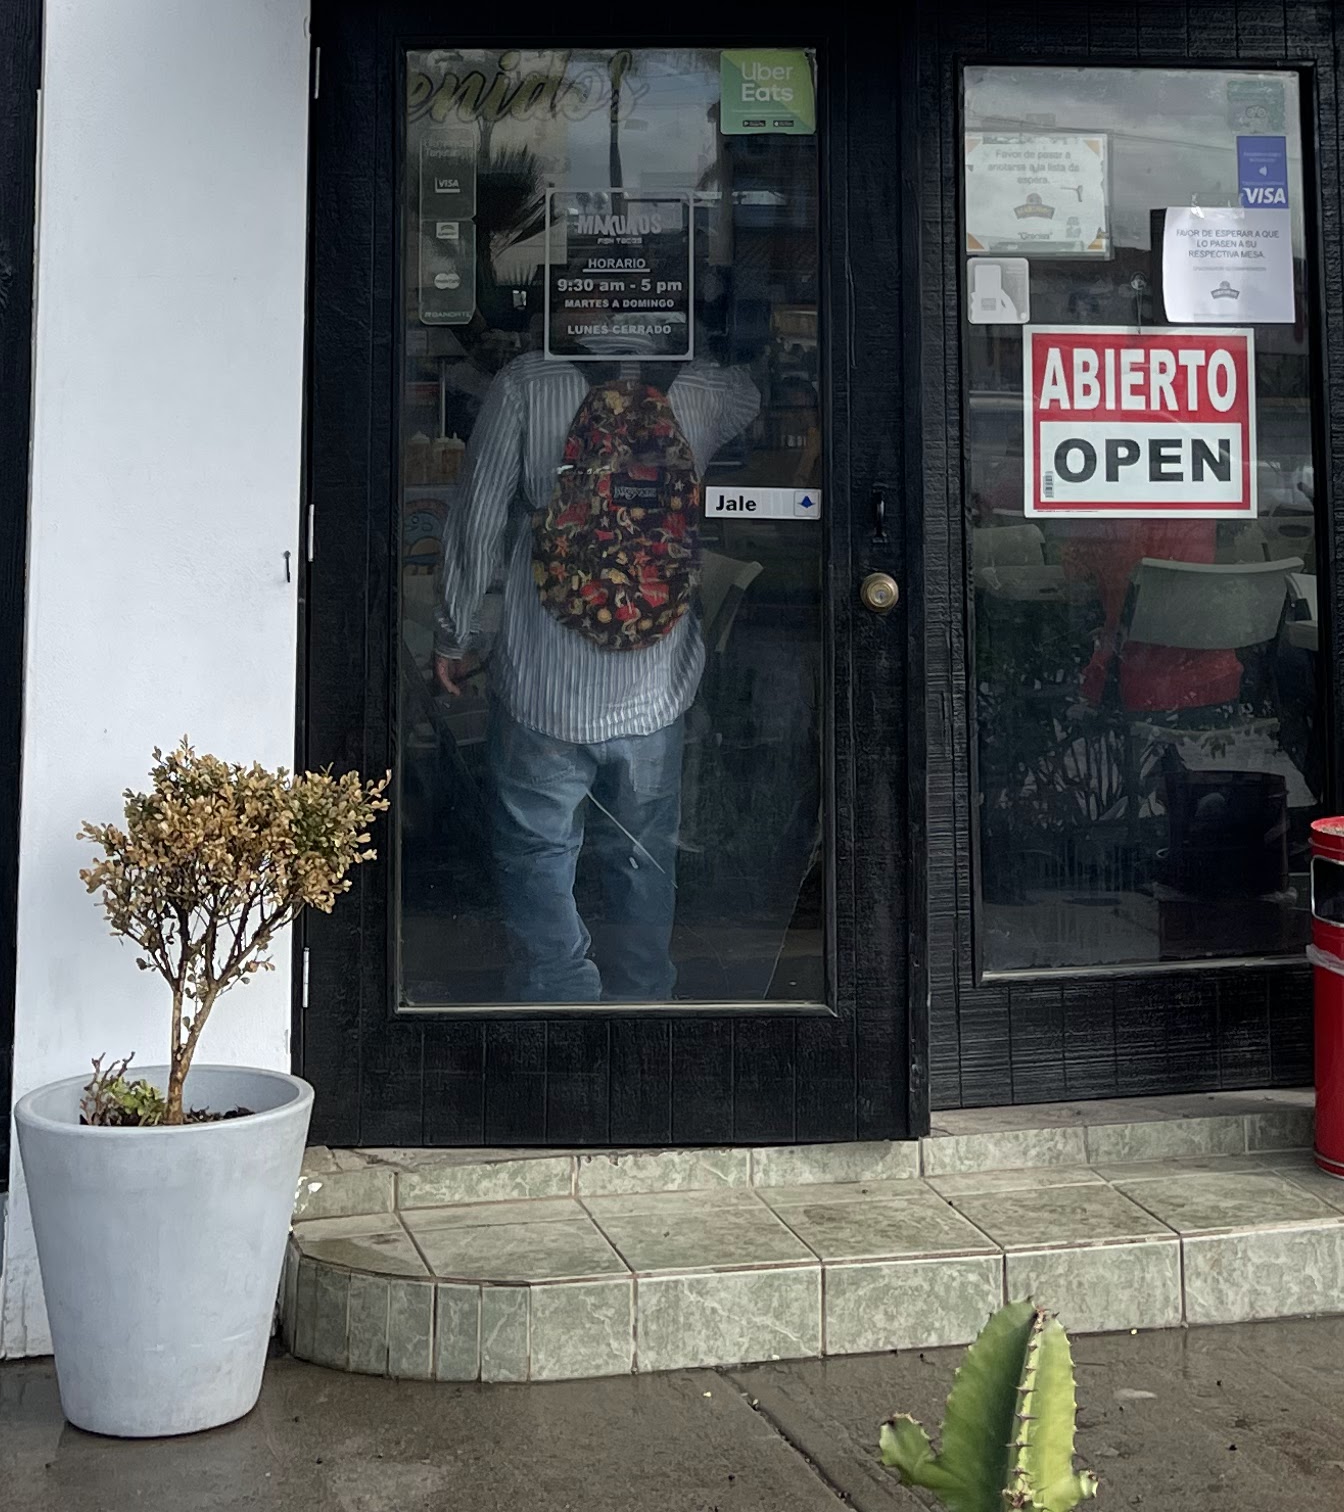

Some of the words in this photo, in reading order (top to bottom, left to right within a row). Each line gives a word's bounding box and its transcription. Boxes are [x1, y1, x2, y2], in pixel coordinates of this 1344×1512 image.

[741, 62, 794, 81] Uber
[741, 82, 794, 102] Eats
[996, 151, 1022, 159] Favor
[1024, 149, 1036, 159] de
[1038, 151, 1063, 161] pasar
[438, 179, 459, 188] VISA
[1242, 187, 1286, 204] VISA
[577, 214, 662, 237] MAKUKOS
[1176, 229, 1200, 237] FAVOR
[1202, 229, 1213, 237] DE
[1262, 230, 1280, 239] QUE
[1197, 240, 1209, 248] LO
[1210, 240, 1237, 248] PASEN
[1238, 240, 1244, 248] A
[1245, 240, 1257, 248] SU
[1189, 250, 1239, 258] RESPECTIVA
[588, 258, 646, 269] HORARIO
[557, 278, 594, 291] 9:30
[599, 281, 625, 291] am
[641, 278, 651, 291] 5
[657, 281, 682, 294] pm
[565, 299, 609, 308] MARTES
[612, 299, 620, 308] A
[623, 299, 674, 308] DOMINGO
[568, 325, 609, 335] LUNES
[613, 325, 672, 335] CERRADO
[1039, 347, 1237, 412] ABIERTO
[1054, 437, 1232, 483] OPEN
[716, 495, 757, 511] Jale
